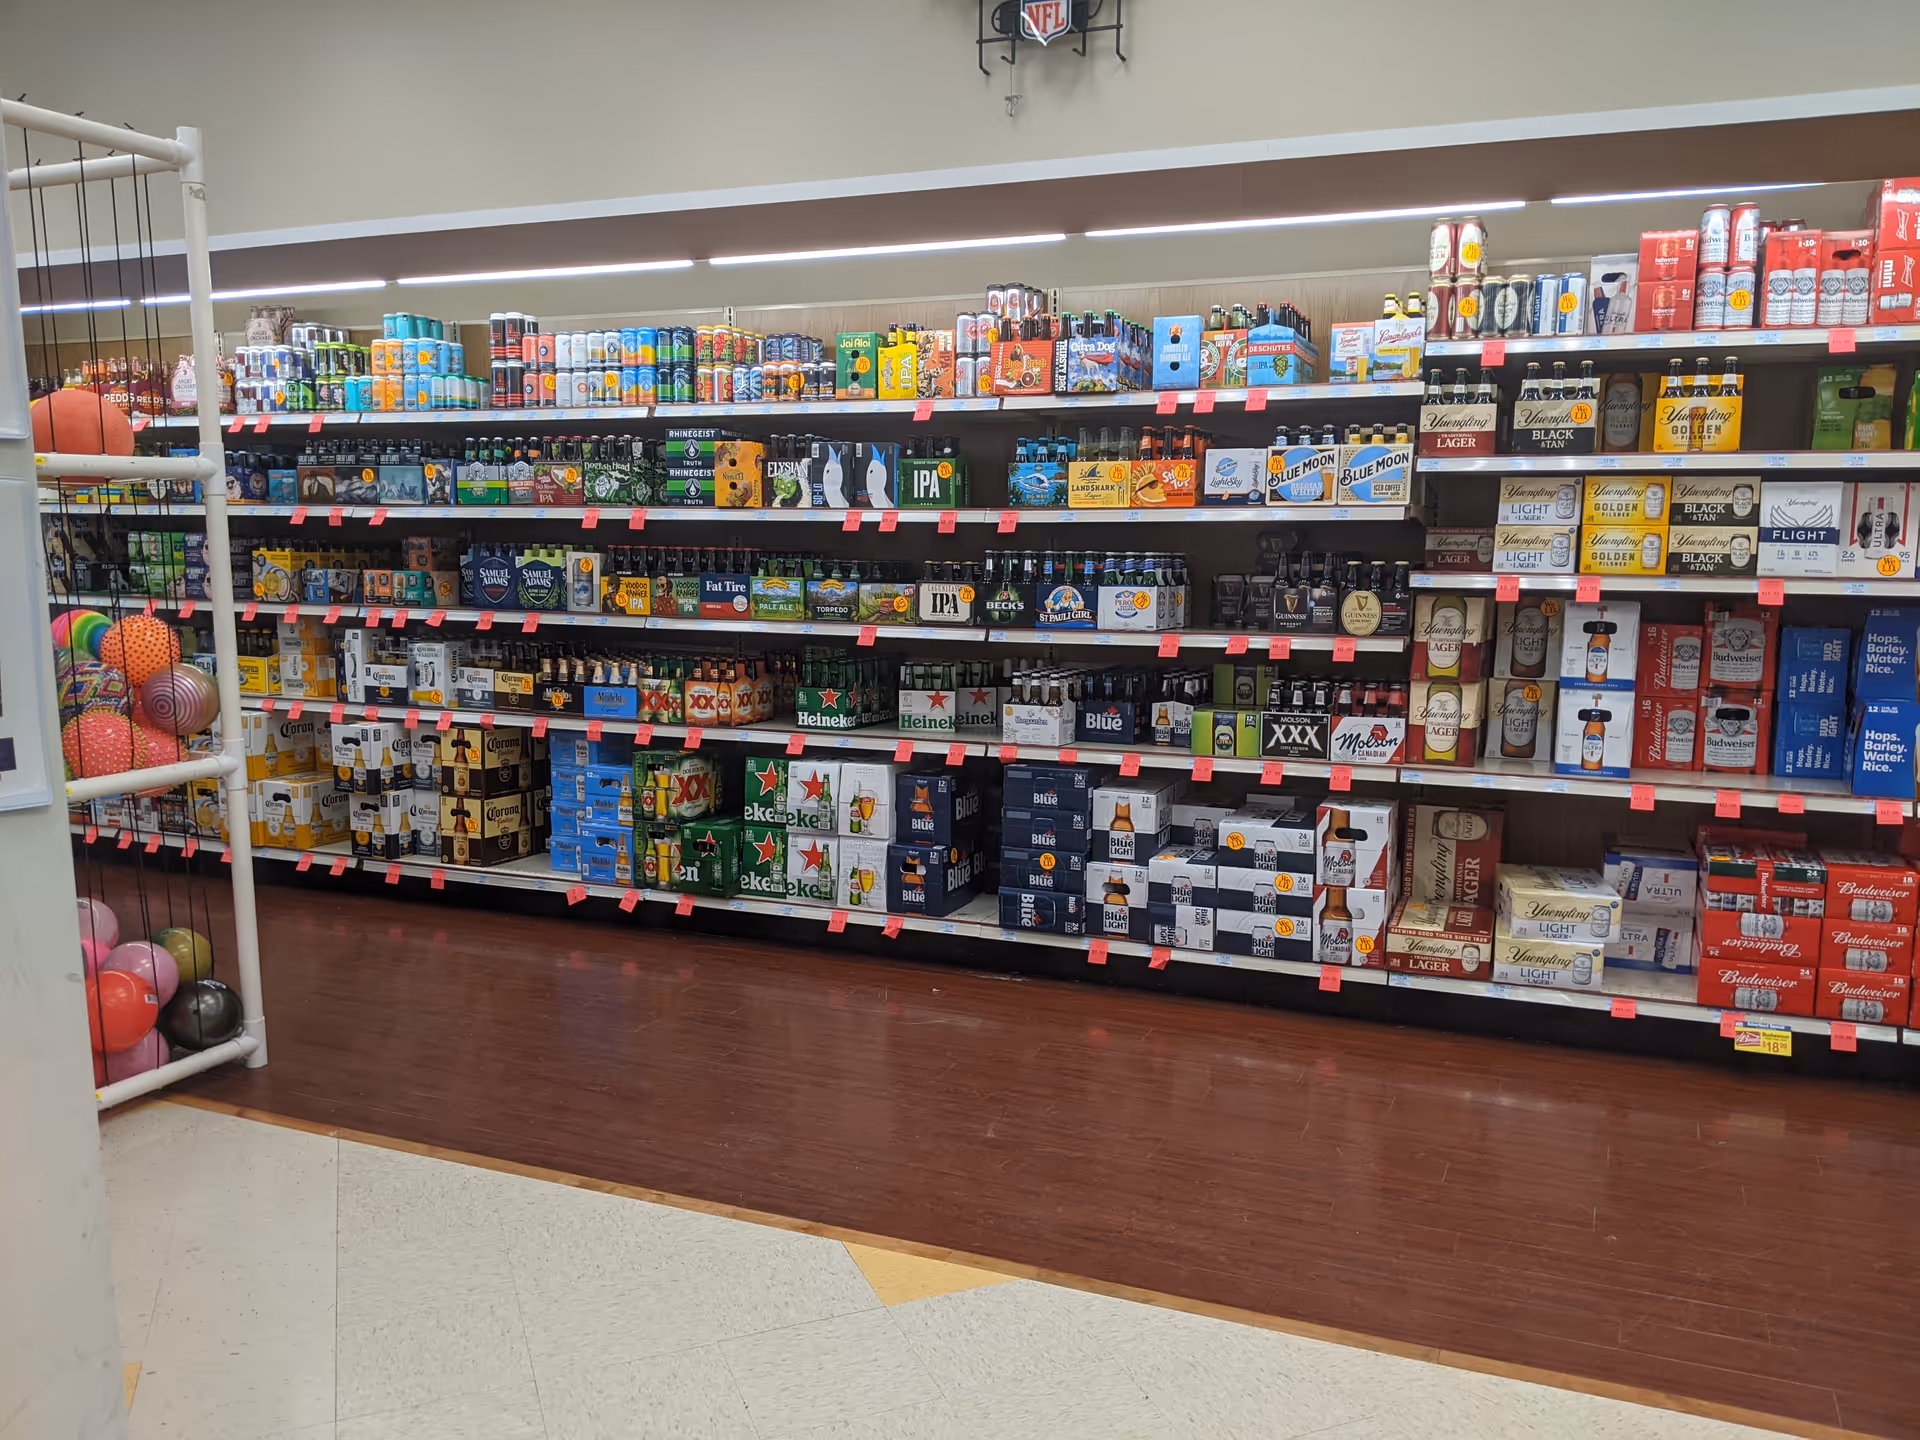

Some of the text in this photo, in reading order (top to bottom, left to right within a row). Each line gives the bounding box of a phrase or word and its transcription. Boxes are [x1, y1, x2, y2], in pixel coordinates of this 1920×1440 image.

[1026, 2, 1064, 34] NFL
[1883, 260, 1895, 287] mini
[840, 339, 871, 348] Jai Alai
[1071, 341, 1115, 353] Citra Dog
[1659, 406, 1736, 425] Yuengling
[1423, 412, 1491, 431] Yuengling
[1532, 430, 1574, 440] BLACK
[1672, 425, 1722, 434] GOLDEN
[1437, 438, 1476, 448] LAGER
[613, 463, 630, 471] Head
[768, 462, 808, 477] ELYSIAN
[1268, 453, 1335, 487] BLUE MOON
[1341, 452, 1409, 486] BLUE MOON
[670, 469, 716, 477] RHINEGEIST
[914, 470, 940, 498] IPA
[1291, 482, 1323, 490] BELGIAN
[813, 483, 823, 505] SO-LO
[1503, 484, 1557, 499] Yuengling
[1588, 483, 1644, 498] Yuengling
[1674, 484, 1732, 499] Yuengling
[539, 494, 554, 503] IPA
[1512, 504, 1550, 514] LIGHT
[1594, 503, 1638, 512] GOLDEN
[1684, 504, 1726, 513] BLACK
[1772, 531, 1826, 540] FLIGHT
[1873, 513, 1884, 547] ULTRA
[1497, 532, 1551, 547] Yuengling
[1585, 533, 1642, 548] Yuengling
[1672, 533, 1729, 548] Yuengling
[1438, 555, 1470, 563] LAGER
[1506, 552, 1544, 562] LIGHT
[1592, 553, 1635, 561] GOLDEN
[1682, 553, 1723, 563] BLACK
[1842, 551, 1855, 559] 2.6
[1899, 551, 1910, 559] 95
[480, 568, 510, 578] SAMUEL
[523, 569, 554, 579] SAMUEL
[482, 577, 508, 586] ADAMS
[525, 578, 551, 587] ADAMS
[625, 581, 647, 589] VOODOO
[675, 581, 699, 589] VOODOO
[706, 581, 746, 592] Fat Tire
[626, 589, 648, 598] RANGER
[676, 589, 699, 598] RANGER
[629, 598, 643, 610] IPA
[684, 604, 693, 612] IPA
[931, 593, 959, 614] IPA
[986, 601, 1025, 610] BECK'S
[1050, 613, 1071, 621] PAULI
[1072, 610, 1092, 619] GIRL
[1275, 612, 1307, 620] GUINNESS
[1419, 622, 1479, 636] Yuengling
[1868, 633, 1902, 644] Hops.
[1867, 644, 1909, 655] Barley.
[1654, 629, 1669, 689] Budweiser
[1713, 652, 1762, 663] Budweiser
[1866, 654, 1906, 664] Water.
[450, 649, 458, 683] Corona
[1865, 664, 1894, 674] Rice.
[373, 671, 396, 681] Corona
[1818, 670, 1826, 693] Water.
[639, 691, 669, 711] XX
[689, 694, 716, 710] XX
[1414, 706, 1473, 722] Yuengling
[1085, 712, 1122, 731] Blue
[1648, 702, 1663, 761] Budweiser
[1865, 730, 1900, 742] Hops.
[1265, 724, 1323, 752] XXX
[1335, 732, 1398, 755] Molson
[1707, 737, 1755, 748] Budweiser
[486, 736, 520, 753] Corona
[1864, 741, 1907, 752] Barley.
[1358, 750, 1387, 758] CANADIAN
[1863, 751, 1905, 763] Water.
[1823, 752, 1831, 769] Rice.
[1862, 762, 1892, 772] Rice.
[672, 773, 710, 805] XX
[418, 807, 437, 816] Corona
[486, 803, 520, 821] Corona
[911, 818, 935, 831] Blue
[1110, 848, 1134, 856] LIGHT
[1254, 862, 1277, 870] LIGHT
[903, 890, 925, 902] Blue
[1837, 882, 1910, 899] Budweiser
[1525, 901, 1591, 921] Yuengling
[1539, 923, 1577, 934] LIGHT
[1832, 931, 1904, 948] Budweiser
[1402, 938, 1459, 955] Yuengling
[1722, 938, 1801, 957] Budweiser
[1506, 946, 1573, 966] Yuengling
[1520, 968, 1558, 979] LIGHT
[1718, 969, 1798, 988] Budweiser
[1828, 981, 1900, 998] Budweiser
